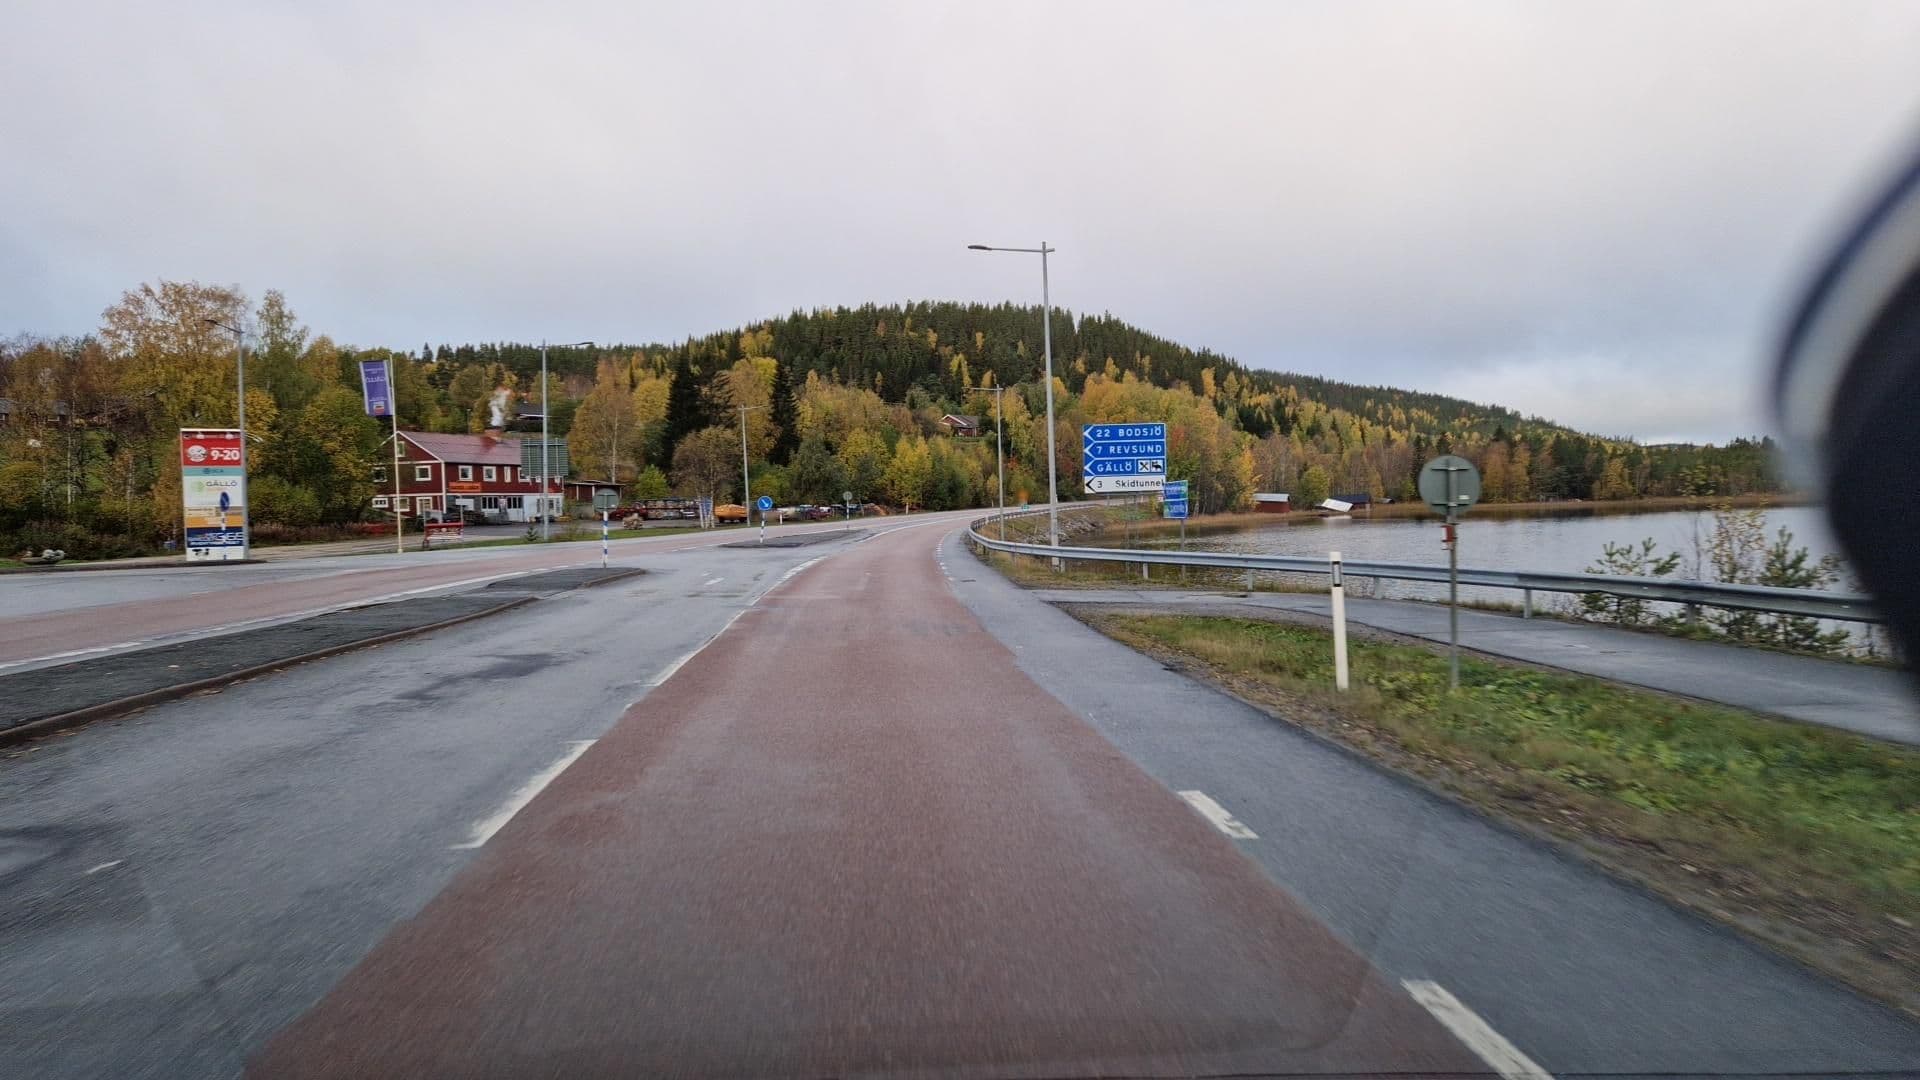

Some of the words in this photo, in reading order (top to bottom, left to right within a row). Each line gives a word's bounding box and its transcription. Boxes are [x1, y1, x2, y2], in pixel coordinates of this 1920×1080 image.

[1096, 429, 1111, 438] 22
[1118, 425, 1162, 437] BODSJÖ
[210, 449, 240, 461] 9-20
[1097, 446, 1103, 455] 7
[1109, 444, 1162, 454] REVSUND
[1096, 461, 1133, 473] GÄLLÖ
[206, 479, 238, 487] GÄLLÖ
[1097, 480, 1103, 489] 3
[1115, 478, 1165, 489] Skidtunnel
